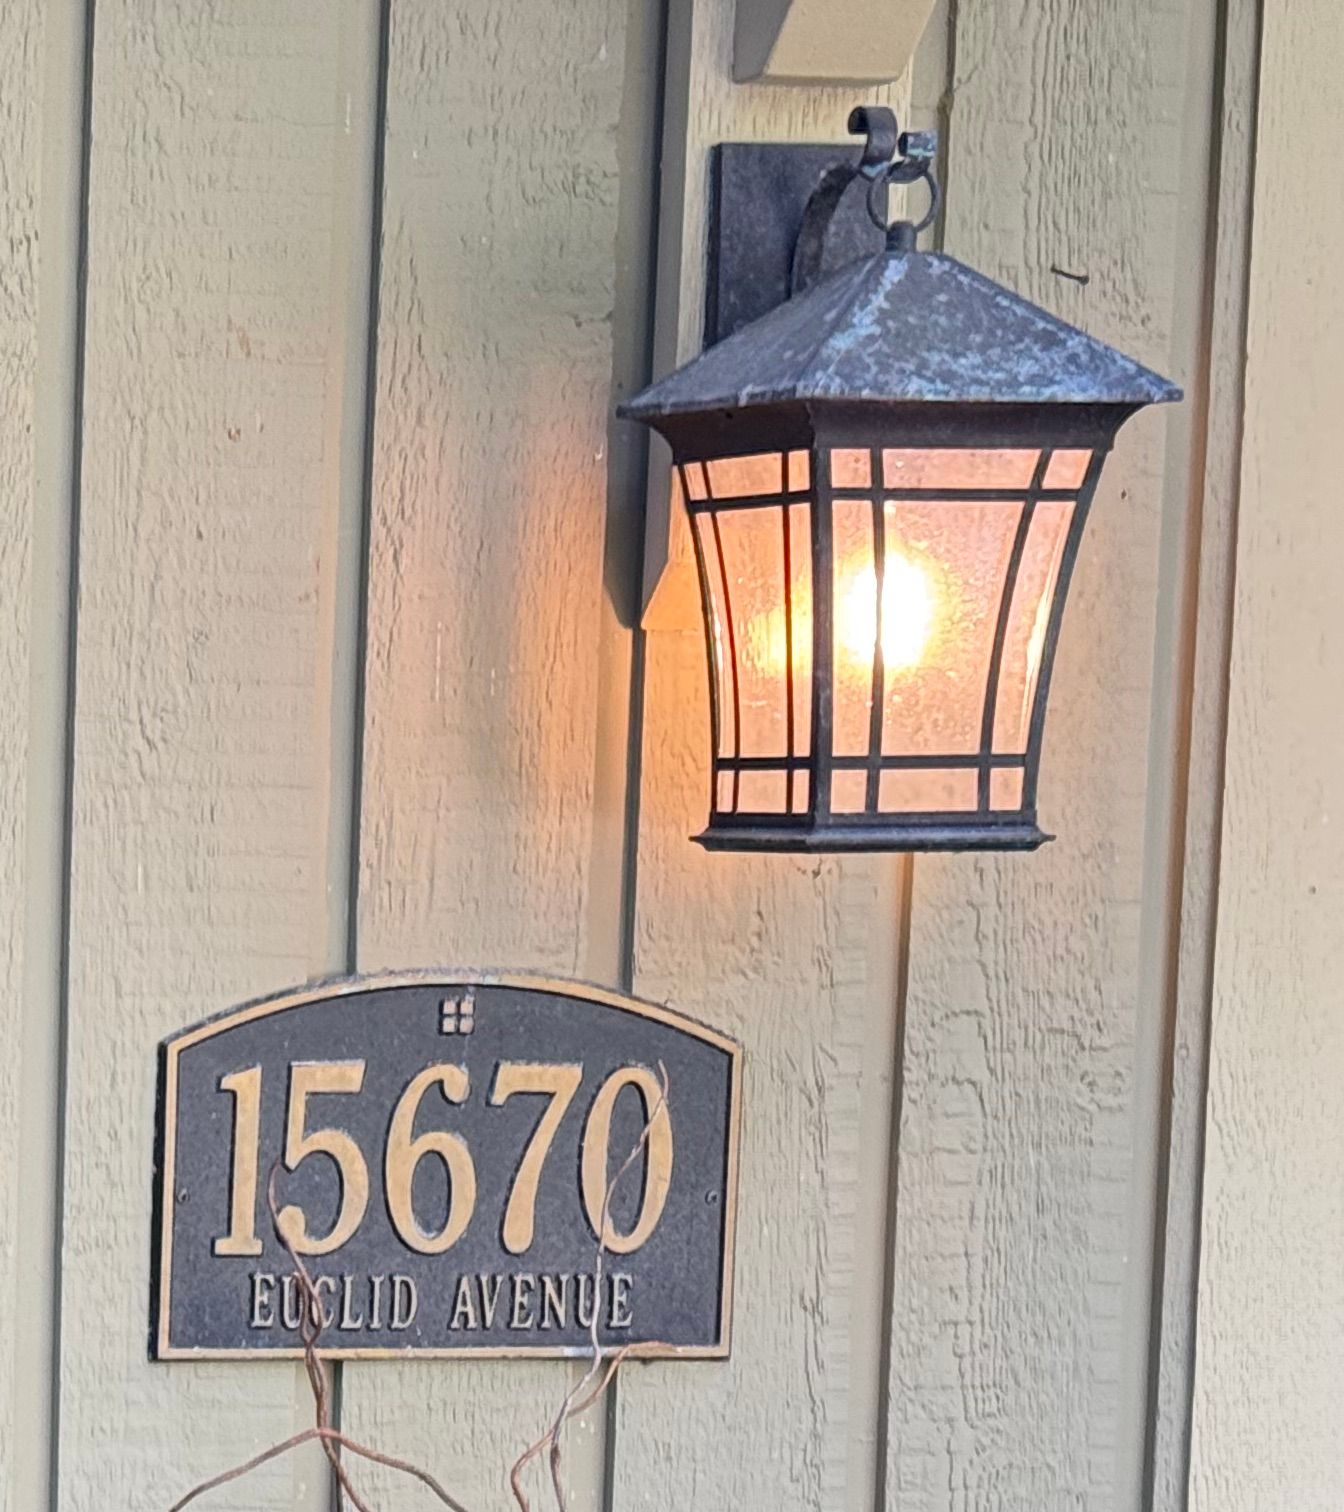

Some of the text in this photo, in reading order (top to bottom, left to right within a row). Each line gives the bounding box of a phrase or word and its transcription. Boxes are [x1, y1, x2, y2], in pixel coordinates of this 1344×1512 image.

[214, 1059, 673, 1256] 15670
[251, 1272, 634, 1330] EUCLID AVENUE
